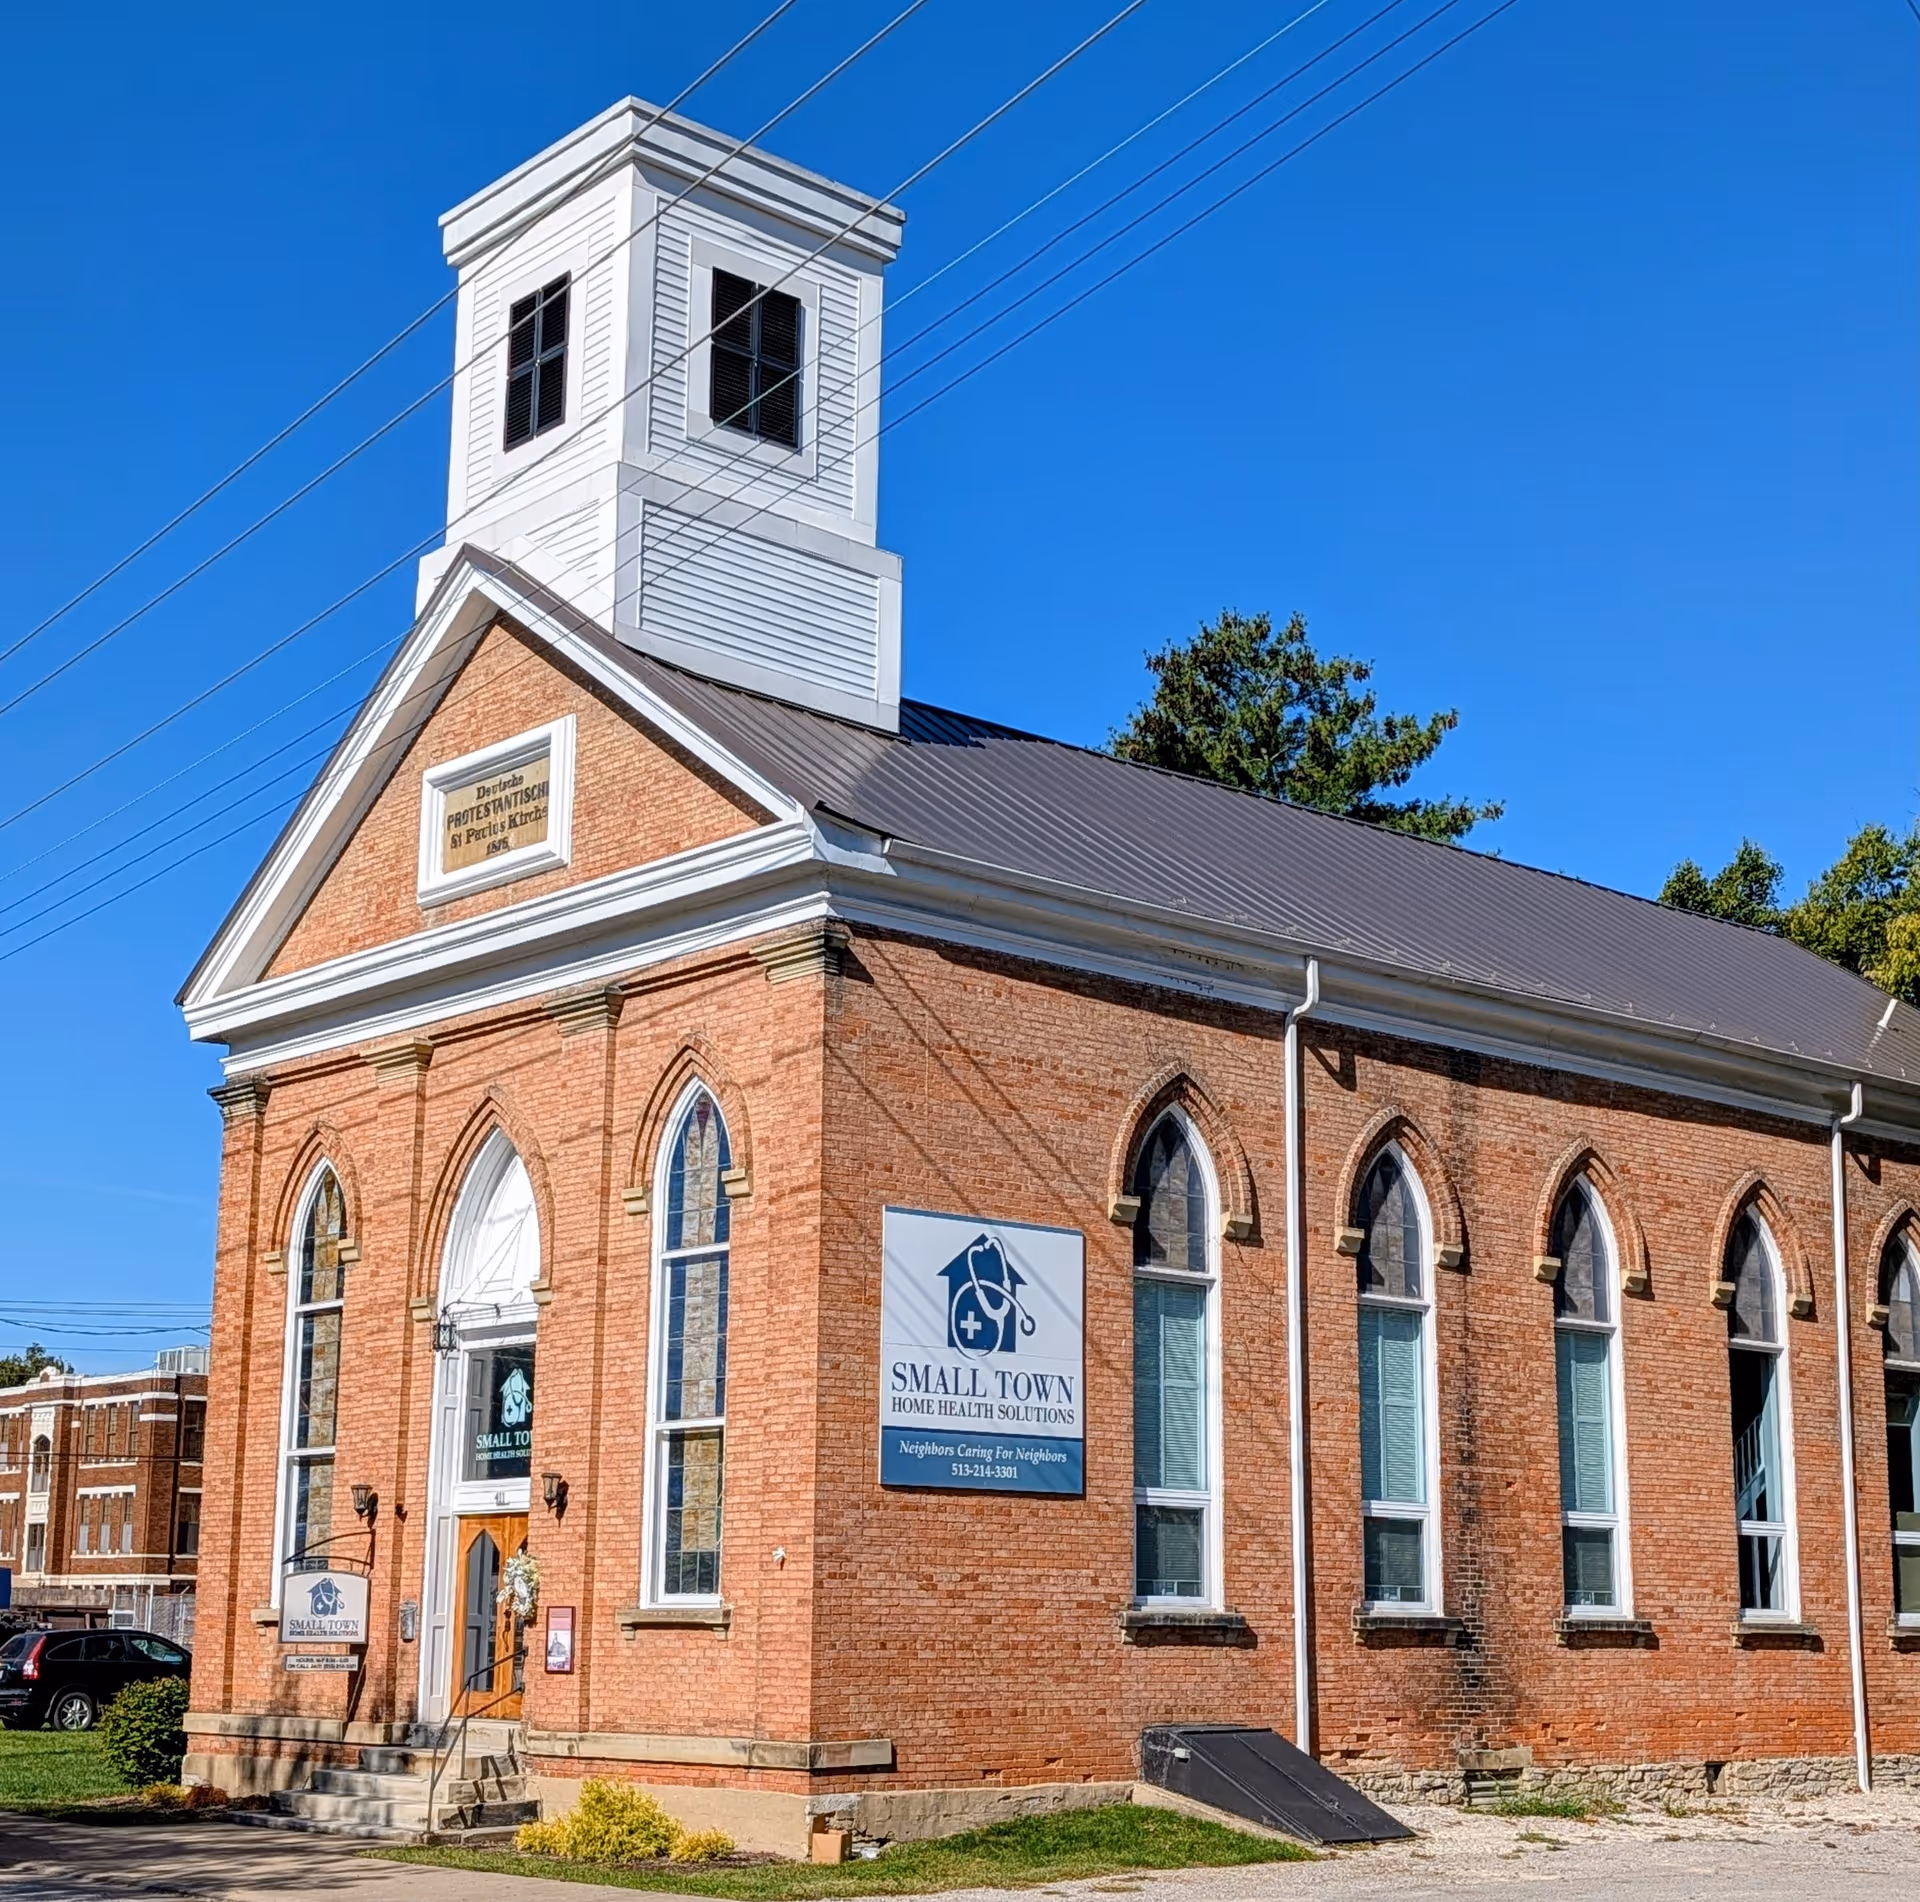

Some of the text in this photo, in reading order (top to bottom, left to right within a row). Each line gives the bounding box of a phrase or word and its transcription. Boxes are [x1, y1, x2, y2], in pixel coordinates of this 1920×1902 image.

[465, 821, 506, 844] Paulus
[507, 805, 548, 830] Kirche
[891, 1361, 1075, 1405] SMALL TOWN
[891, 1396, 1075, 1425] HOME HEALTH SOLUTIONS
[476, 1430, 532, 1449] SMALL TO
[476, 1451, 492, 1460] HOME
[899, 1440, 1067, 1465] Neighbors Caring For Neighbors
[951, 1463, 1018, 1479] 513-214-3301
[289, 1619, 359, 1630] SMALL TOWN
